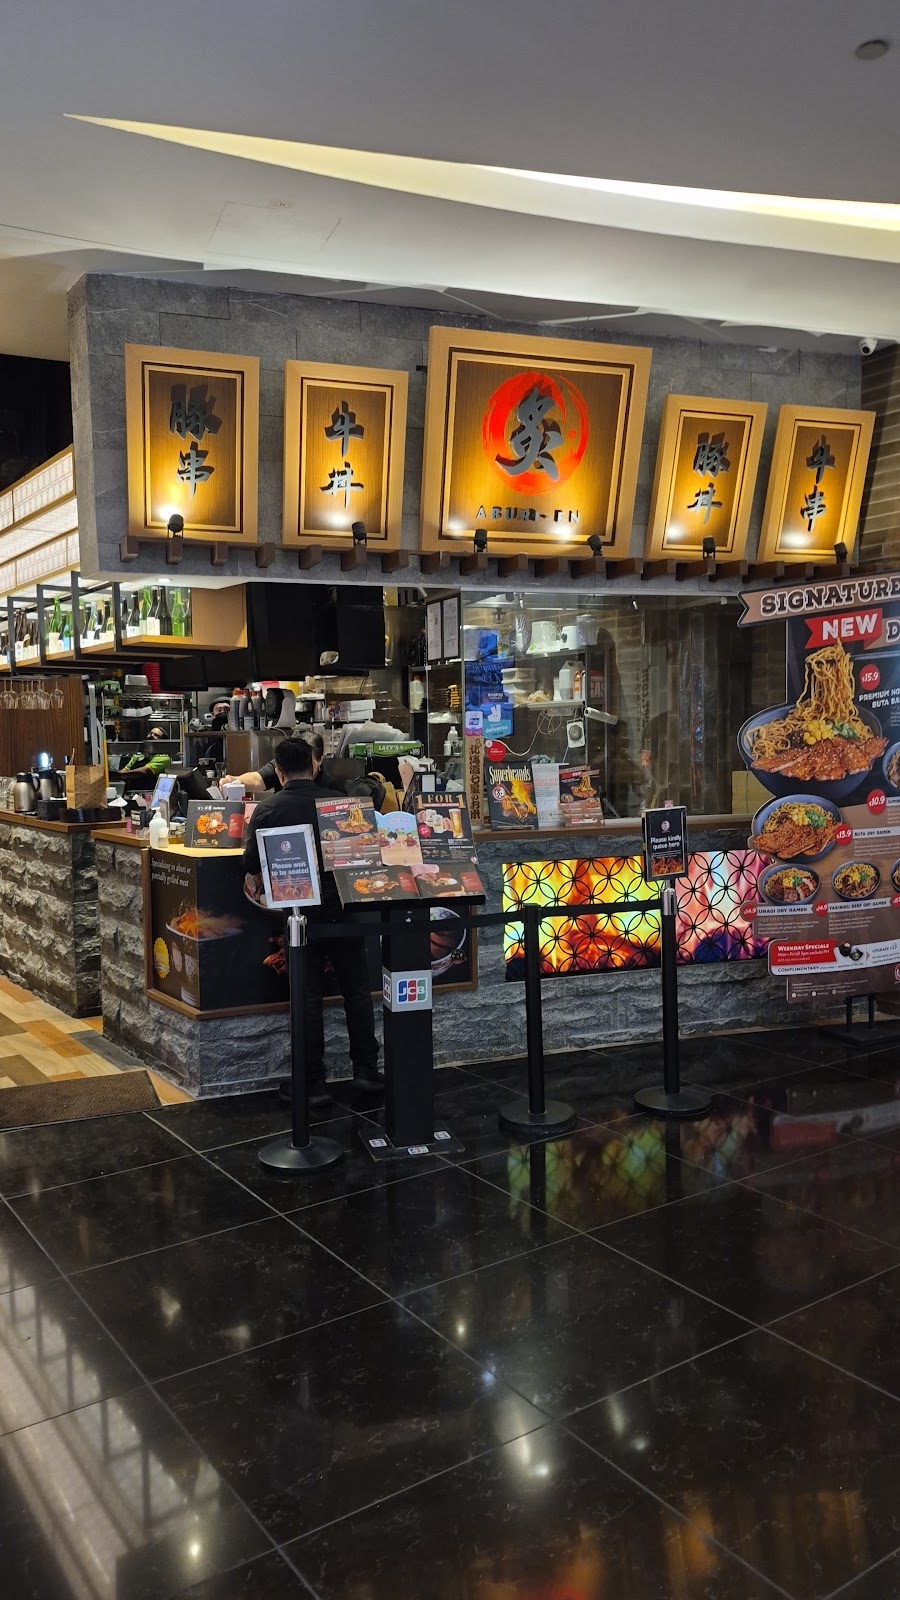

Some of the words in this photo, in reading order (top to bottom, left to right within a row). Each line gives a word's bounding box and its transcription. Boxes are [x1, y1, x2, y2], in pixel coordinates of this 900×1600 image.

[761, 576, 900, 617] SIGNATURE
[822, 613, 878, 641] NEW
[858, 689, 890, 702] PREMIUM
[872, 700, 890, 709] BUTA
[488, 765, 532, 785] Superbrands
[427, 794, 453, 803] FOR
[668, 834, 682, 843] kindly
[652, 843, 668, 851] queue
[271, 862, 292, 870] Please
[288, 867, 309, 875] seated
[777, 965, 820, 973] COMPLIMENTARY
